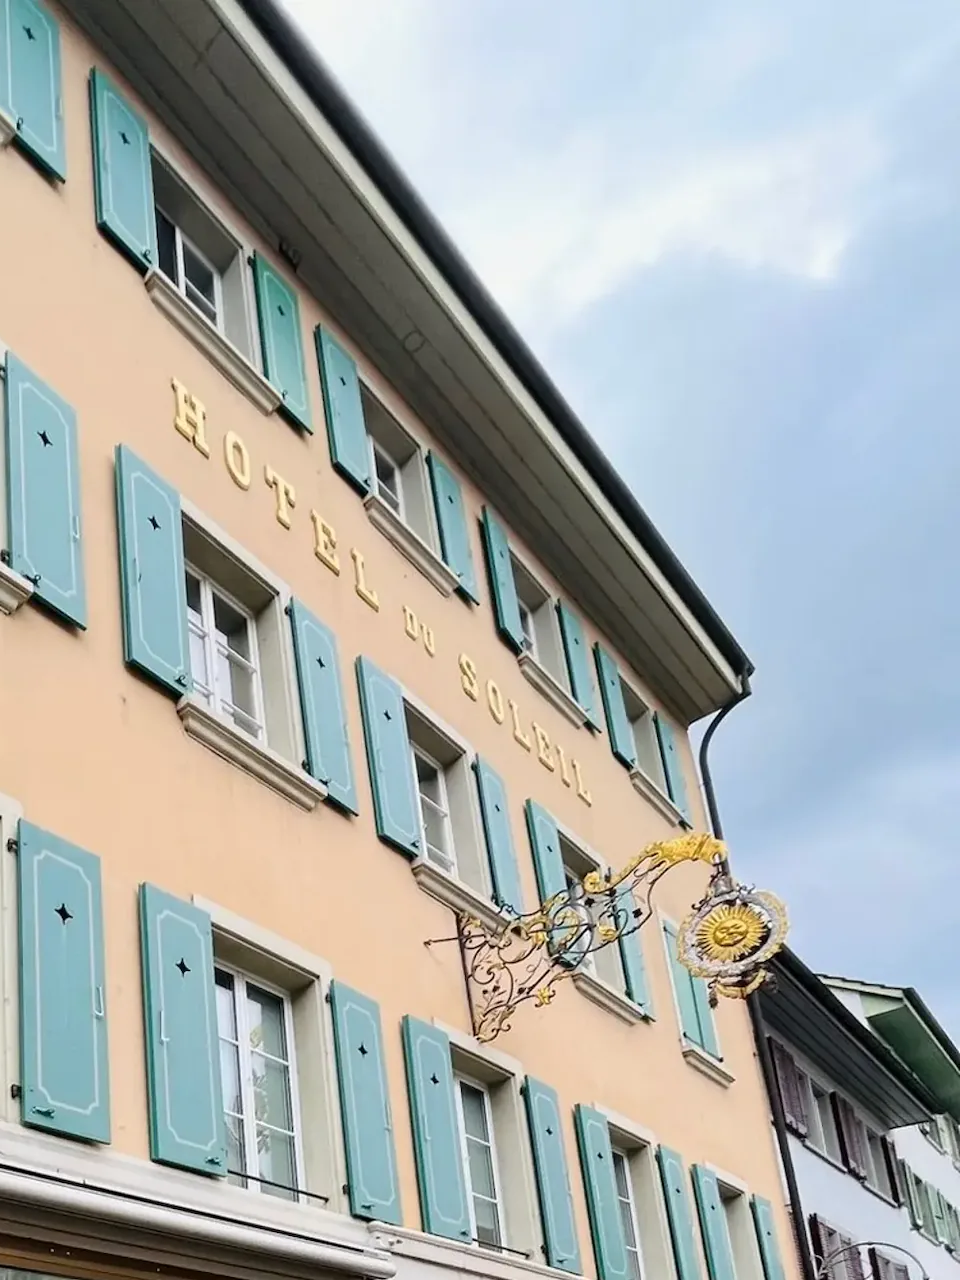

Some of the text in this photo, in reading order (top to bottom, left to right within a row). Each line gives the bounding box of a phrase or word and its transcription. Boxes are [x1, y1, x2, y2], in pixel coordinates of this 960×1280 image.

[171, 377, 592, 807] HOTEL DU SOLEIL
